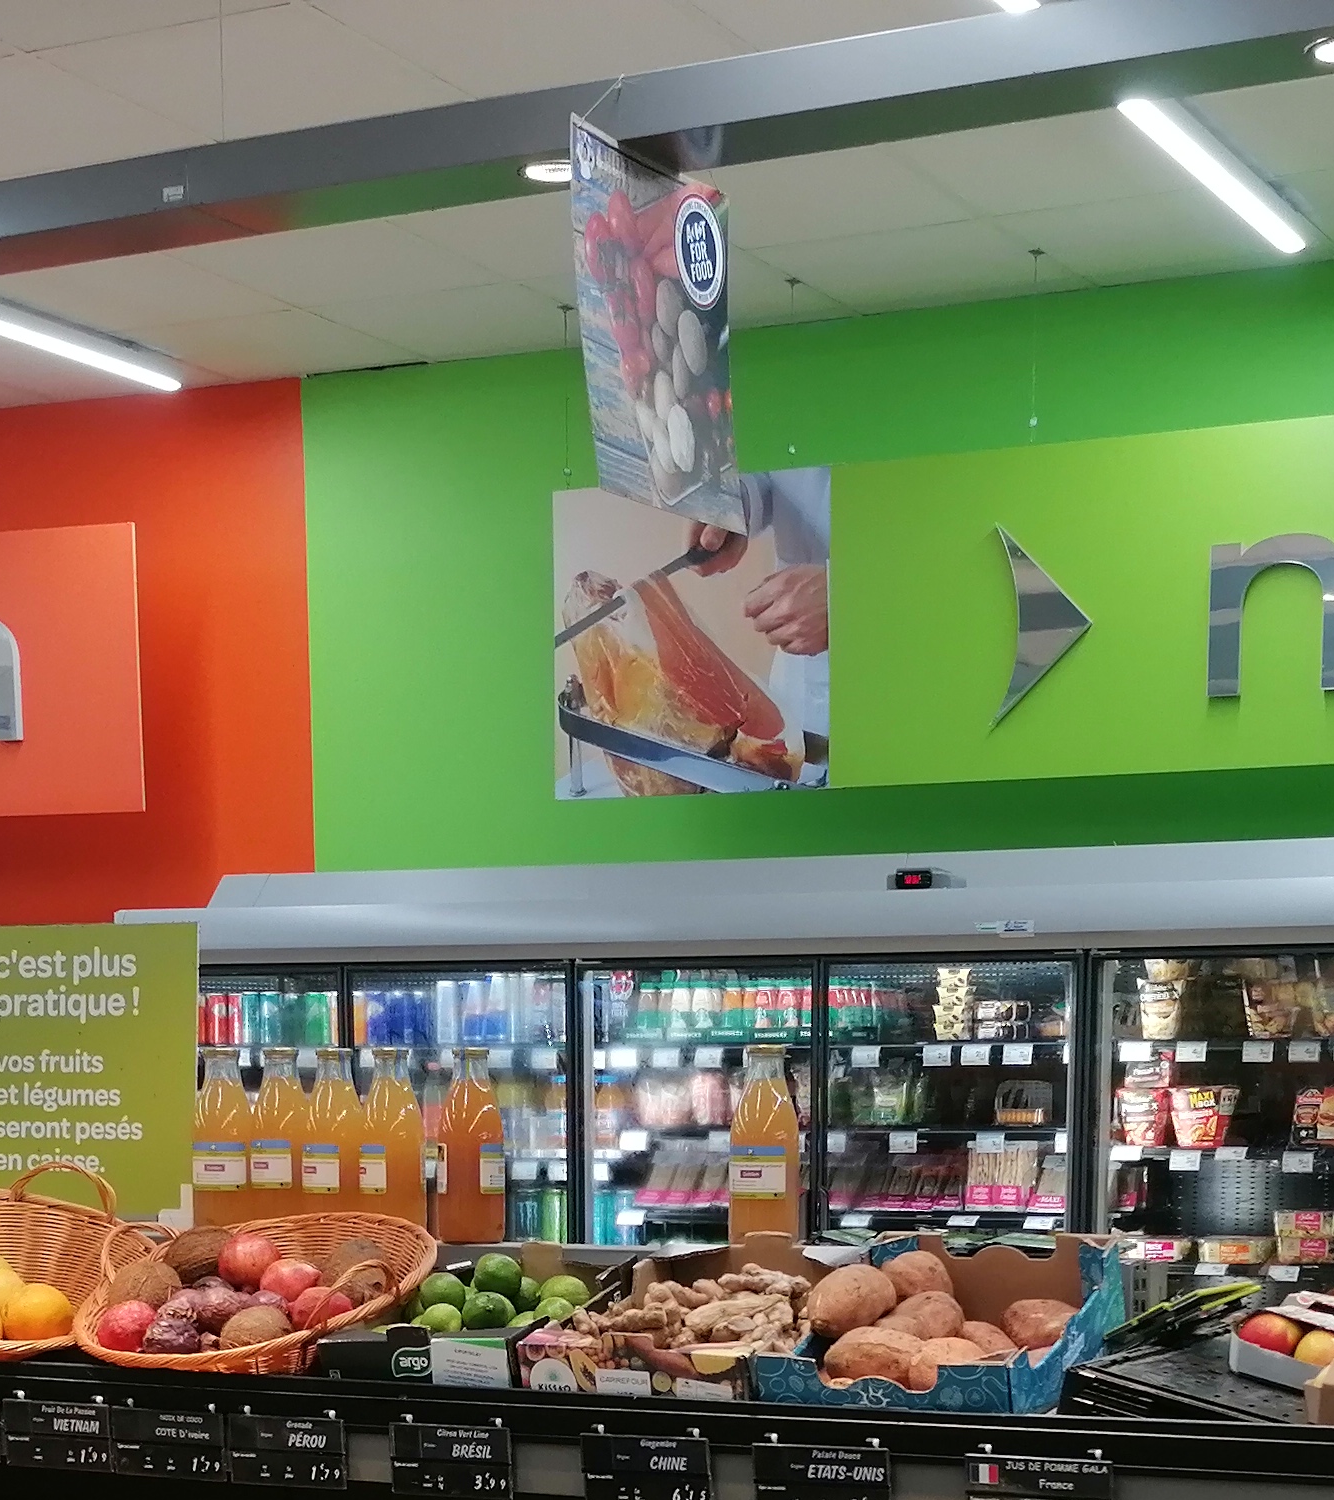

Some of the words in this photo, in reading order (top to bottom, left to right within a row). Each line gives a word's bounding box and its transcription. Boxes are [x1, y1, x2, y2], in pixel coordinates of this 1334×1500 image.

[689, 241, 708, 262] FOR
[690, 260, 713, 283] FOOD
[72, 946, 137, 985] plus
[39, 1048, 105, 1074] fruits
[22, 1082, 122, 1112] légumes
[75, 1116, 144, 1146] pesés
[53, 1417, 100, 1434] VIETNAM
[287, 1431, 327, 1449] PÉROU
[451, 1441, 493, 1459] BRÉSIL
[649, 1456, 688, 1471] CHINE
[807, 1463, 885, 1482] ETATS-UNIS
[1004, 1460, 1026, 1472] JUS
[1027, 1461, 1041, 1472] DE
[1081, 1464, 1109, 1475] GALA
[1038, 1478, 1075, 1491] France
